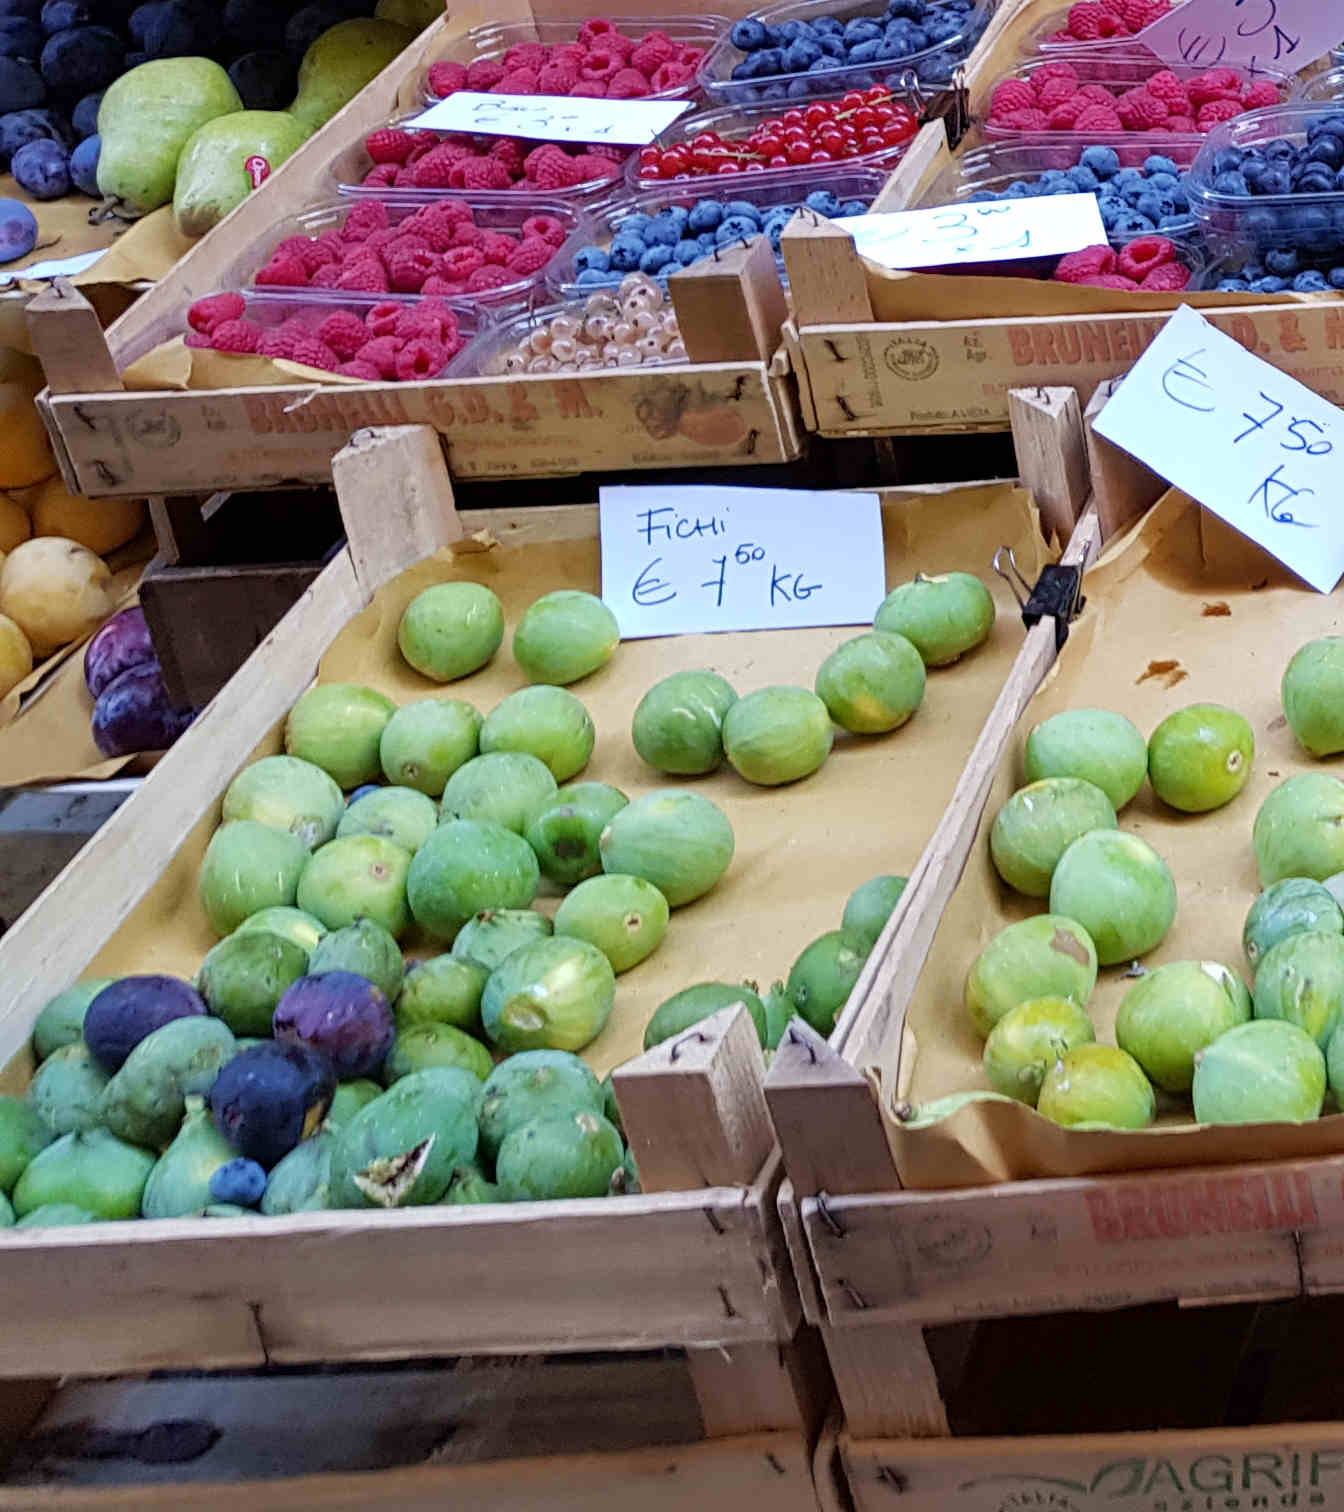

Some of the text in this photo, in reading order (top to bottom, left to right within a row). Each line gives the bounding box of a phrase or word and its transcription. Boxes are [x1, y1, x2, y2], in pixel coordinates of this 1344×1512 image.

[1162, 347, 1217, 412] €
[632, 557, 678, 606] €
[770, 564, 824, 607] KG
